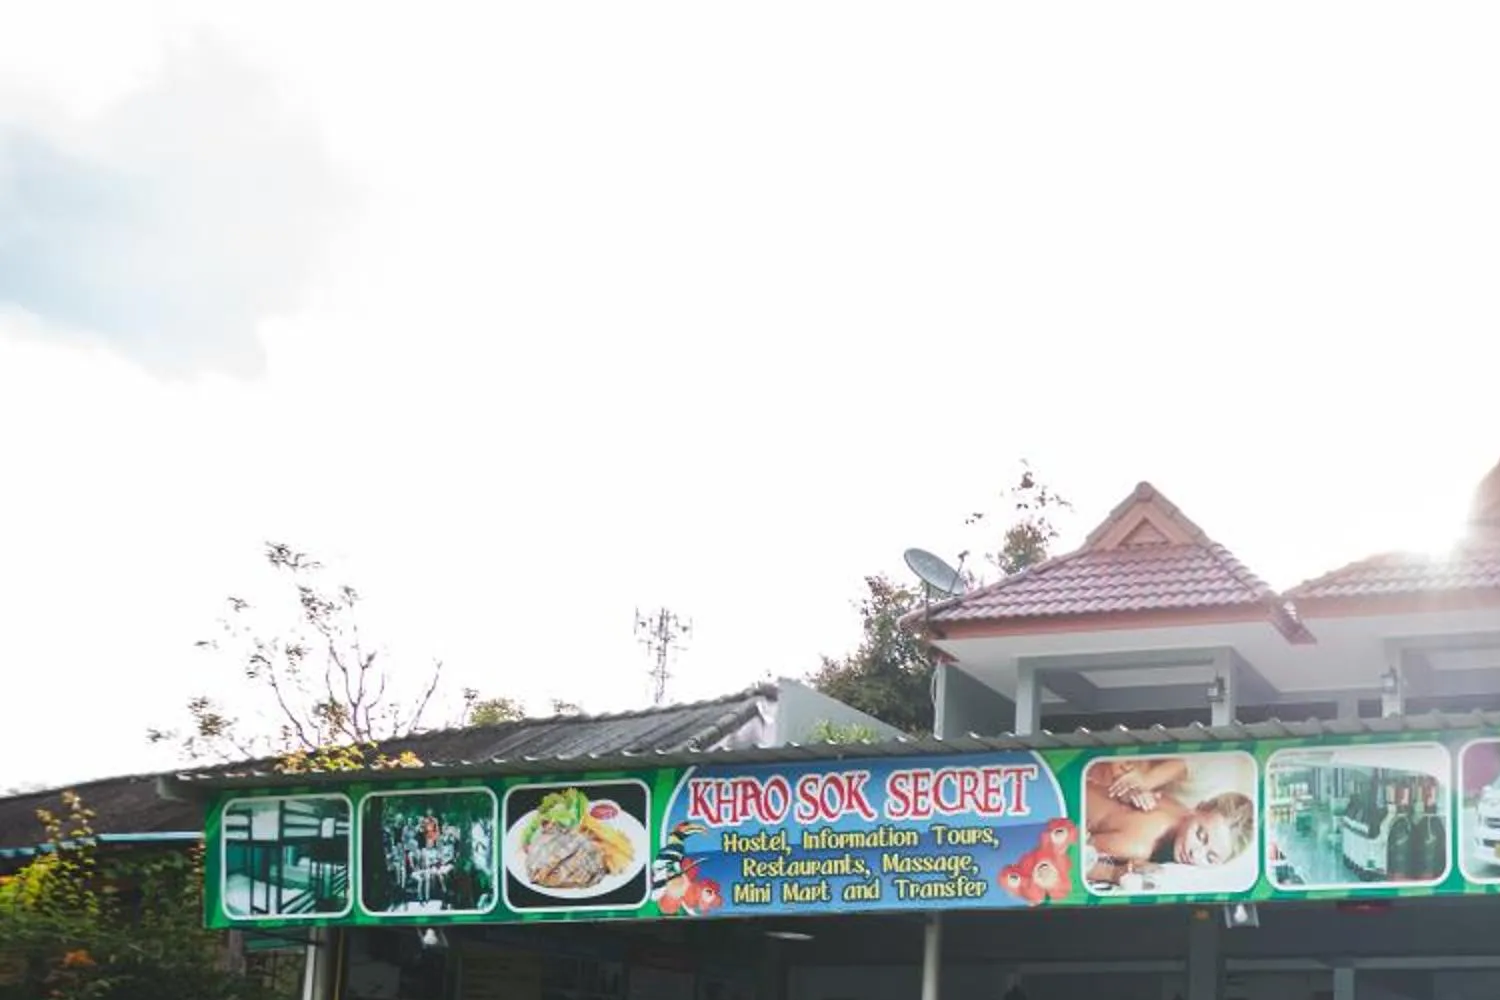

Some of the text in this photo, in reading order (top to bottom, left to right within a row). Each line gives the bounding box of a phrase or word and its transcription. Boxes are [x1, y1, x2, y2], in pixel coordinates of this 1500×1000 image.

[688, 766, 1036, 824] KHAO SOK SECRET
[722, 823, 1000, 856] Hostel, Information Tours,
[742, 851, 981, 879] Restaurants, Massage,
[733, 876, 987, 904] Mini Mart and Transfer
